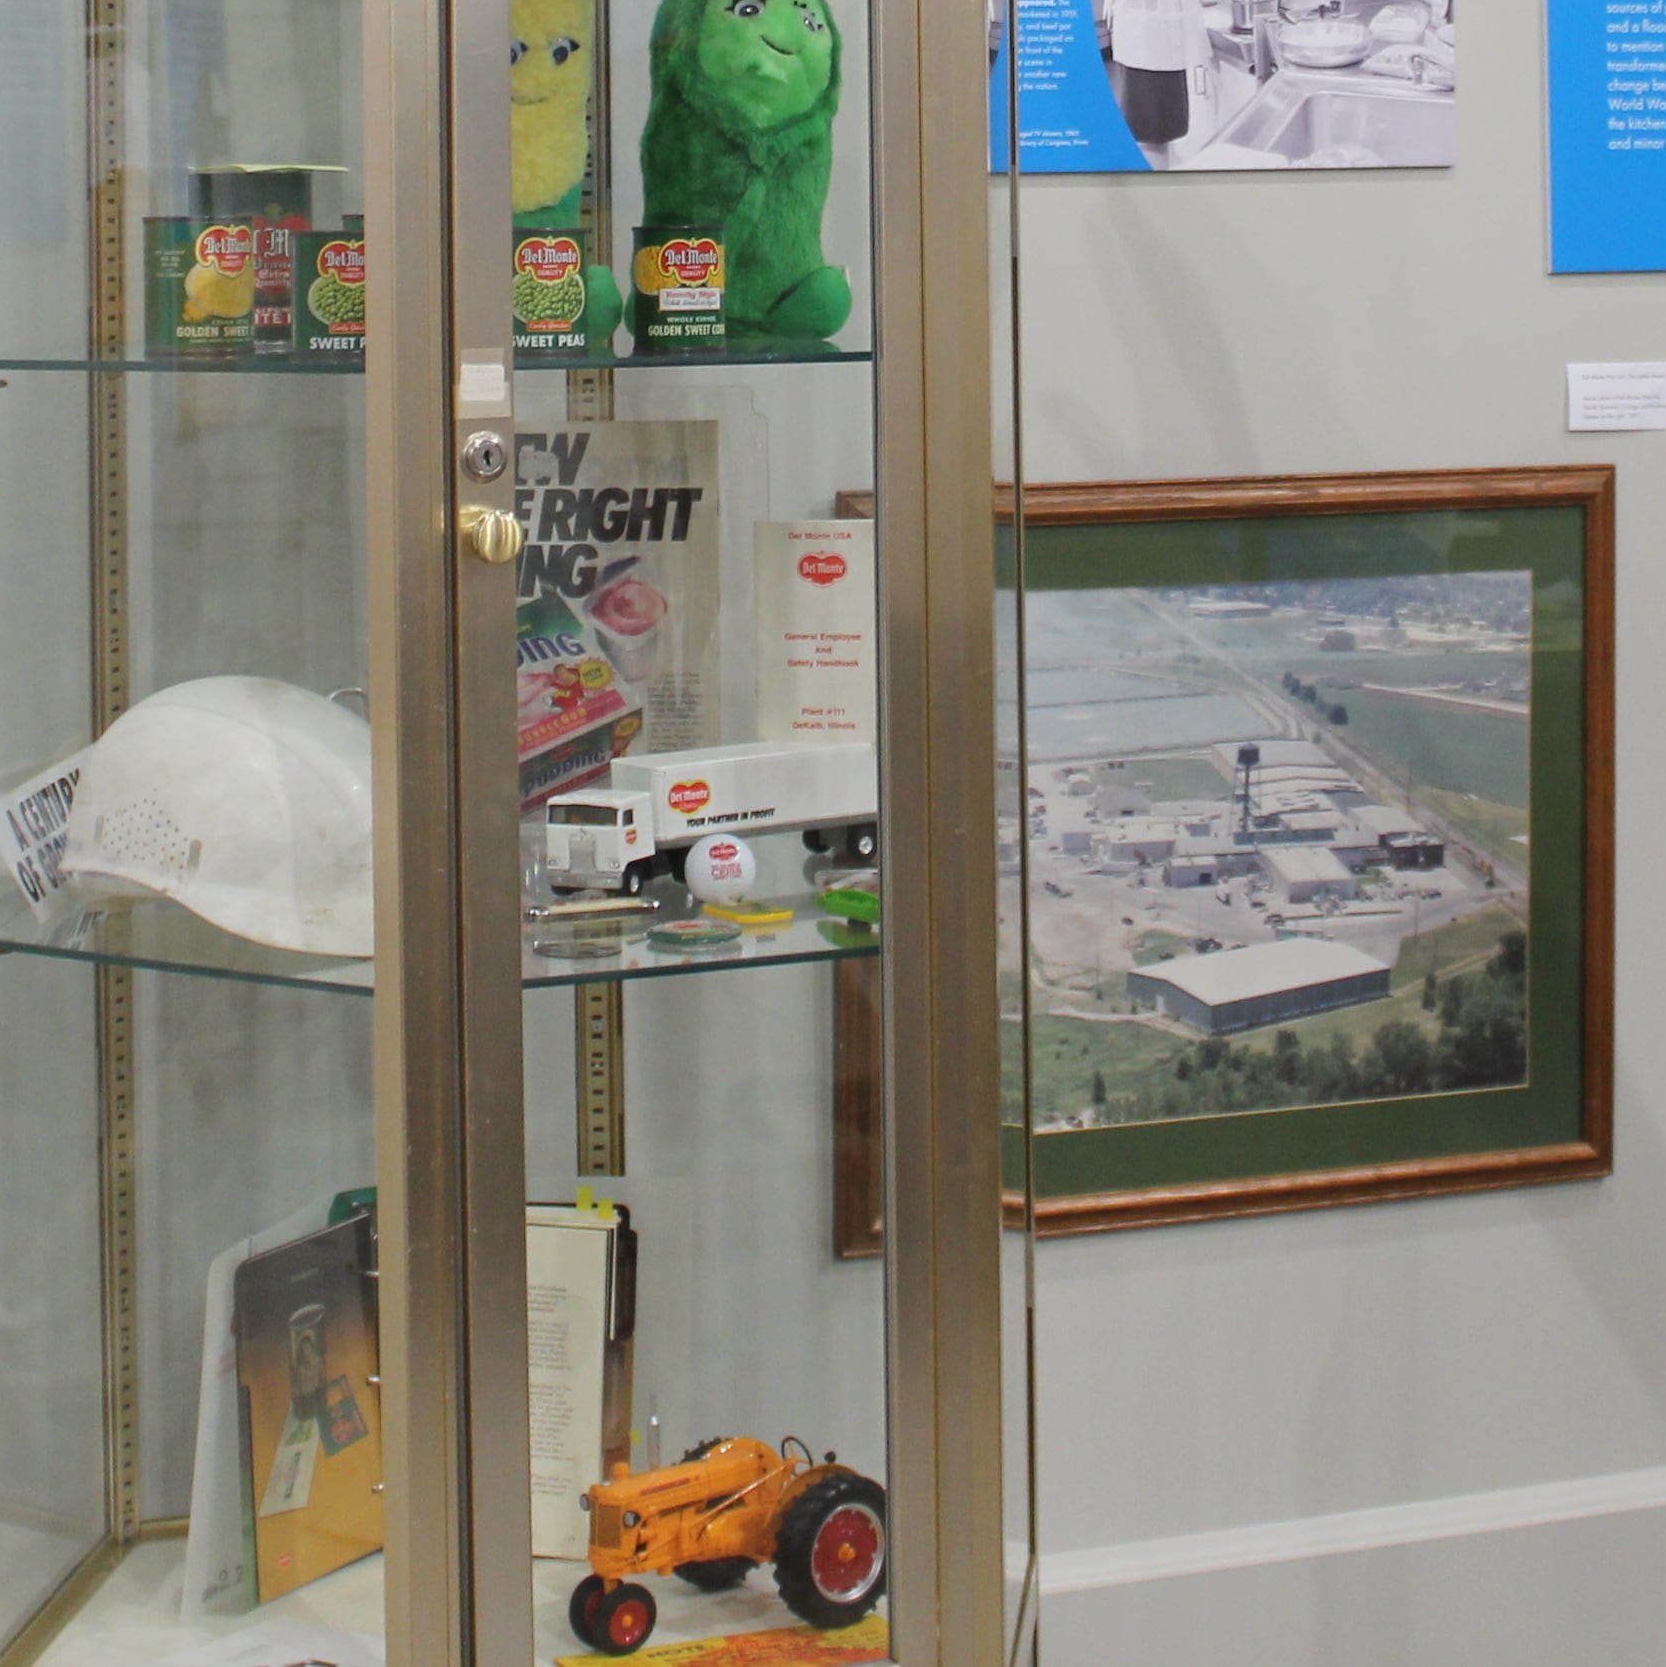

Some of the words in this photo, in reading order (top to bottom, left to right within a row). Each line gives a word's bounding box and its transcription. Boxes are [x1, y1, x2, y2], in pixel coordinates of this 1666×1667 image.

[176, 326, 219, 337] GOLDEN
[223, 326, 249, 336] SWEET
[648, 325, 682, 336] GOLDEN
[685, 324, 711, 336] SWEET
[309, 337, 354, 349] SWEET
[558, 333, 585, 347] PEAS
[537, 488, 703, 542] RIGHT
[821, 633, 861, 642] Employee
[815, 646, 831, 654] And
[787, 660, 813, 668] Safety
[816, 659, 859, 667] Handbook
[687, 818, 705, 828] YOUR
[707, 813, 739, 825] PARTNER
[740, 812, 748, 822] IN
[750, 808, 775, 820] PROFIT
[17, 856, 46, 902] OF
